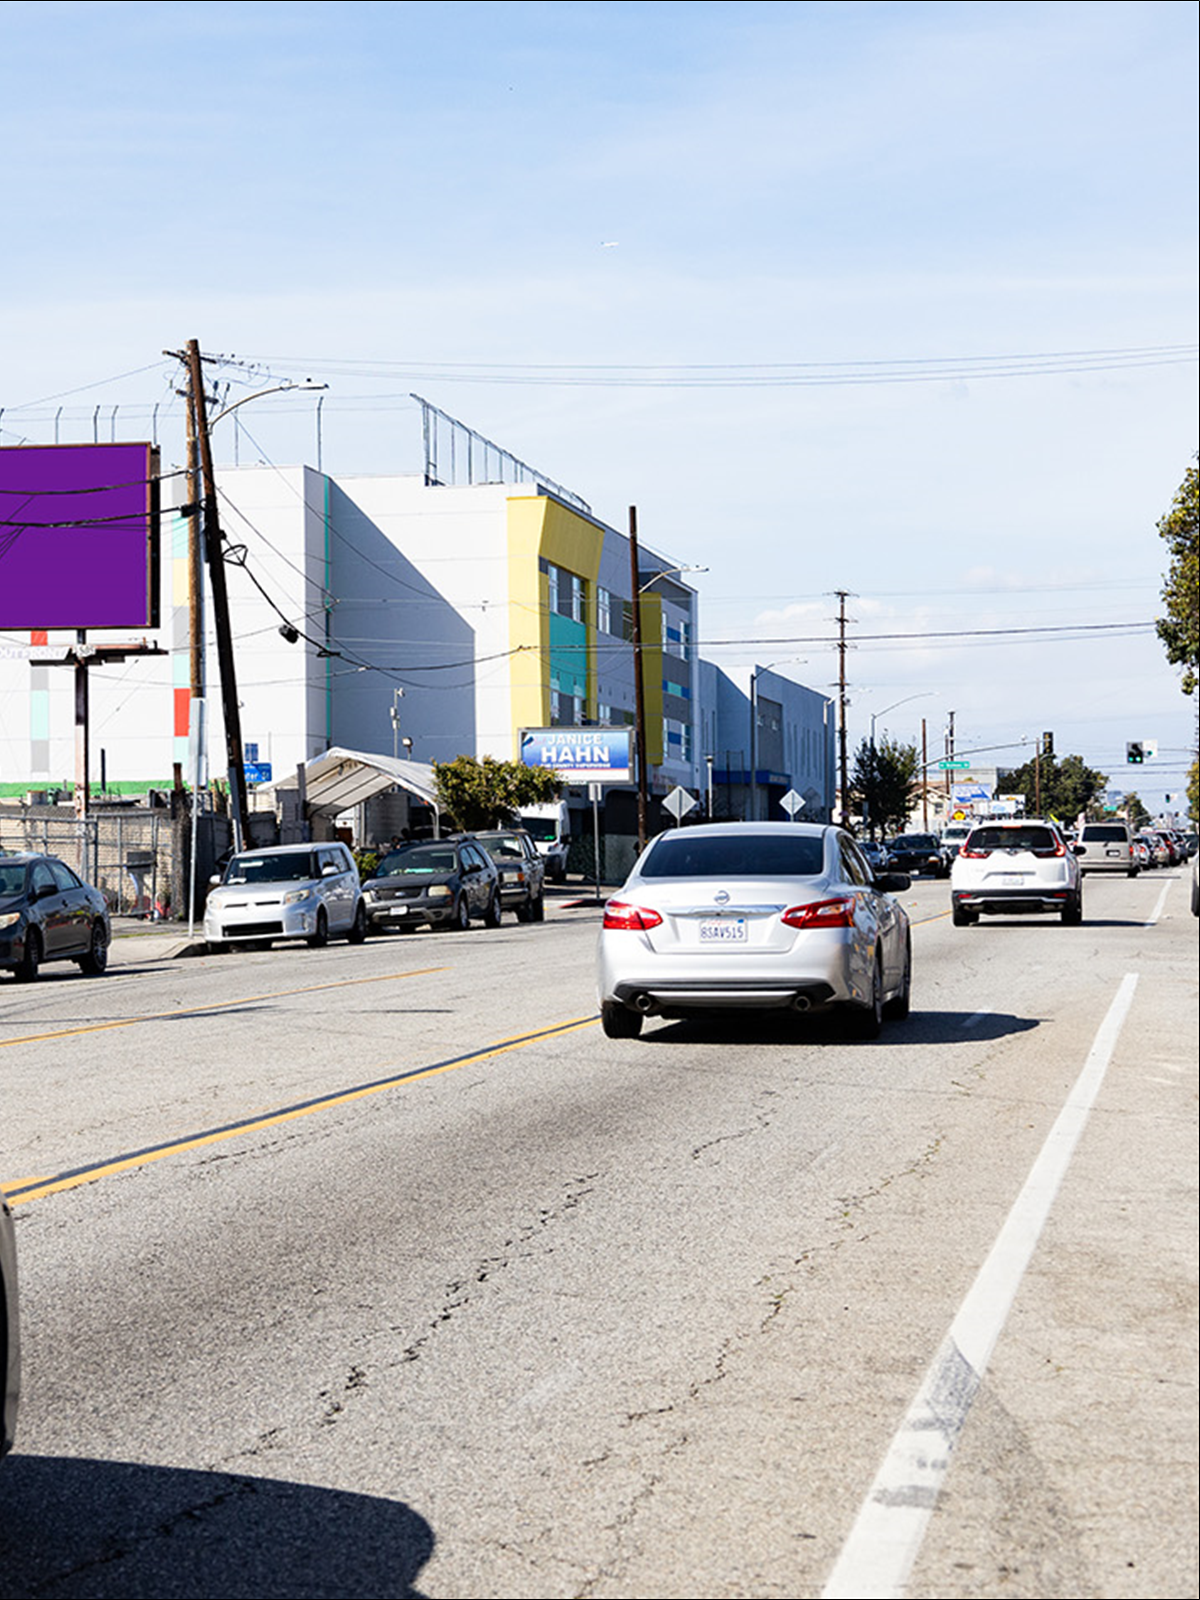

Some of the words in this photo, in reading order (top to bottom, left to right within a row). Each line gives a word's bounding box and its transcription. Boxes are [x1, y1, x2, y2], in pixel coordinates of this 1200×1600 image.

[548, 733, 603, 745] JANICE
[541, 746, 609, 762] HAHN
[700, 926, 744, 939] 8SAV515
